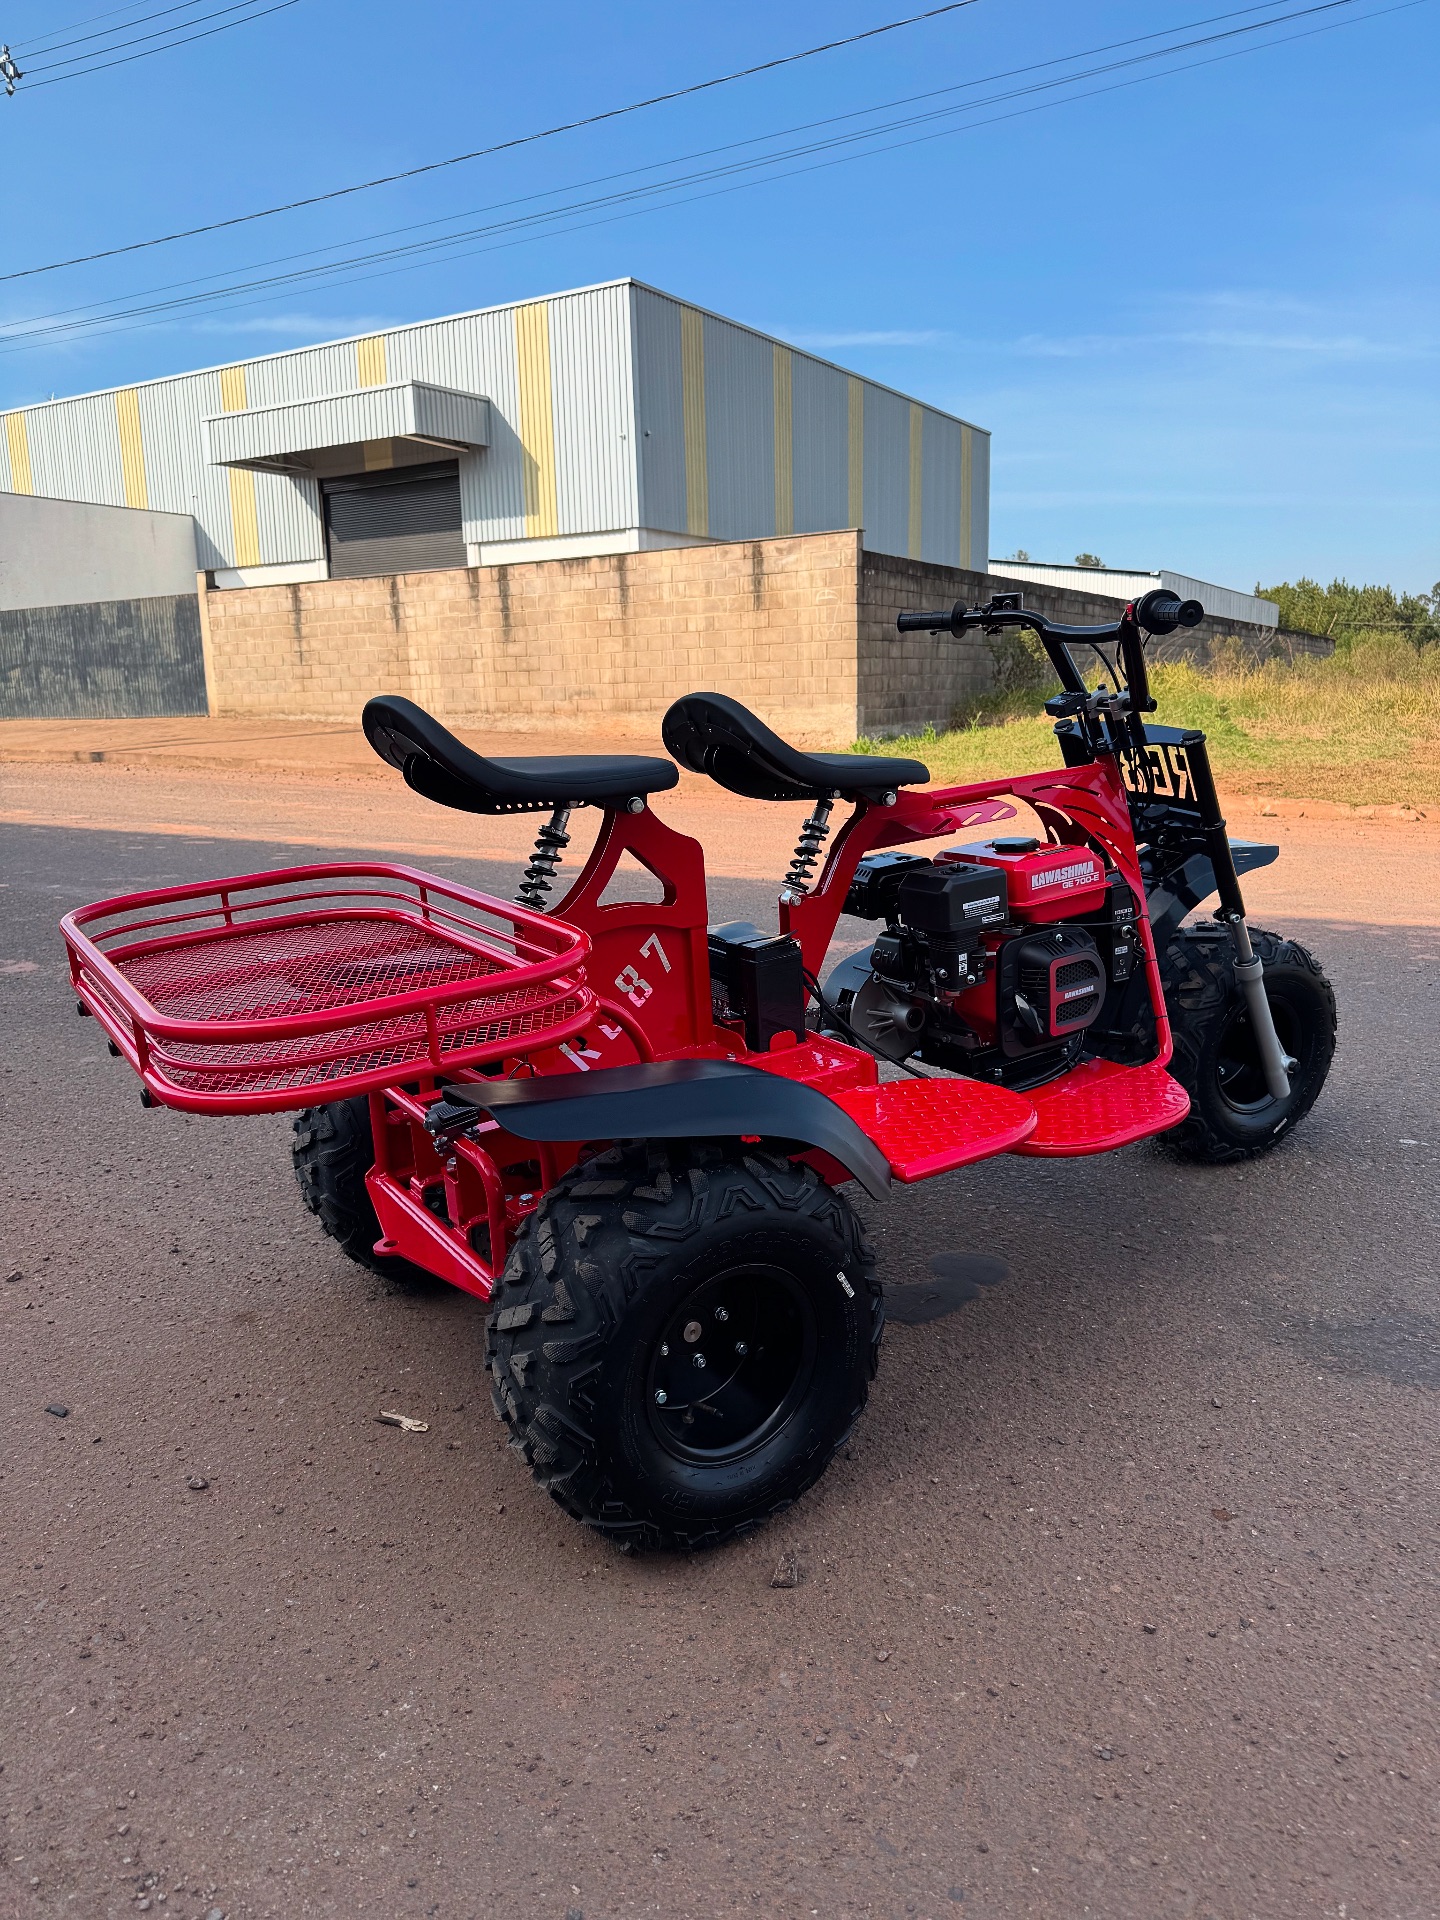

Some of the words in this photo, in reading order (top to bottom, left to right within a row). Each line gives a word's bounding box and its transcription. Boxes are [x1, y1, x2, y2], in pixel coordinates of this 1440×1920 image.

[1031, 860, 1094, 888] KAWASHIMA
[1062, 880, 1074, 889] GE
[1075, 873, 1100, 886] 700-E
[873, 948, 899, 965] OHV
